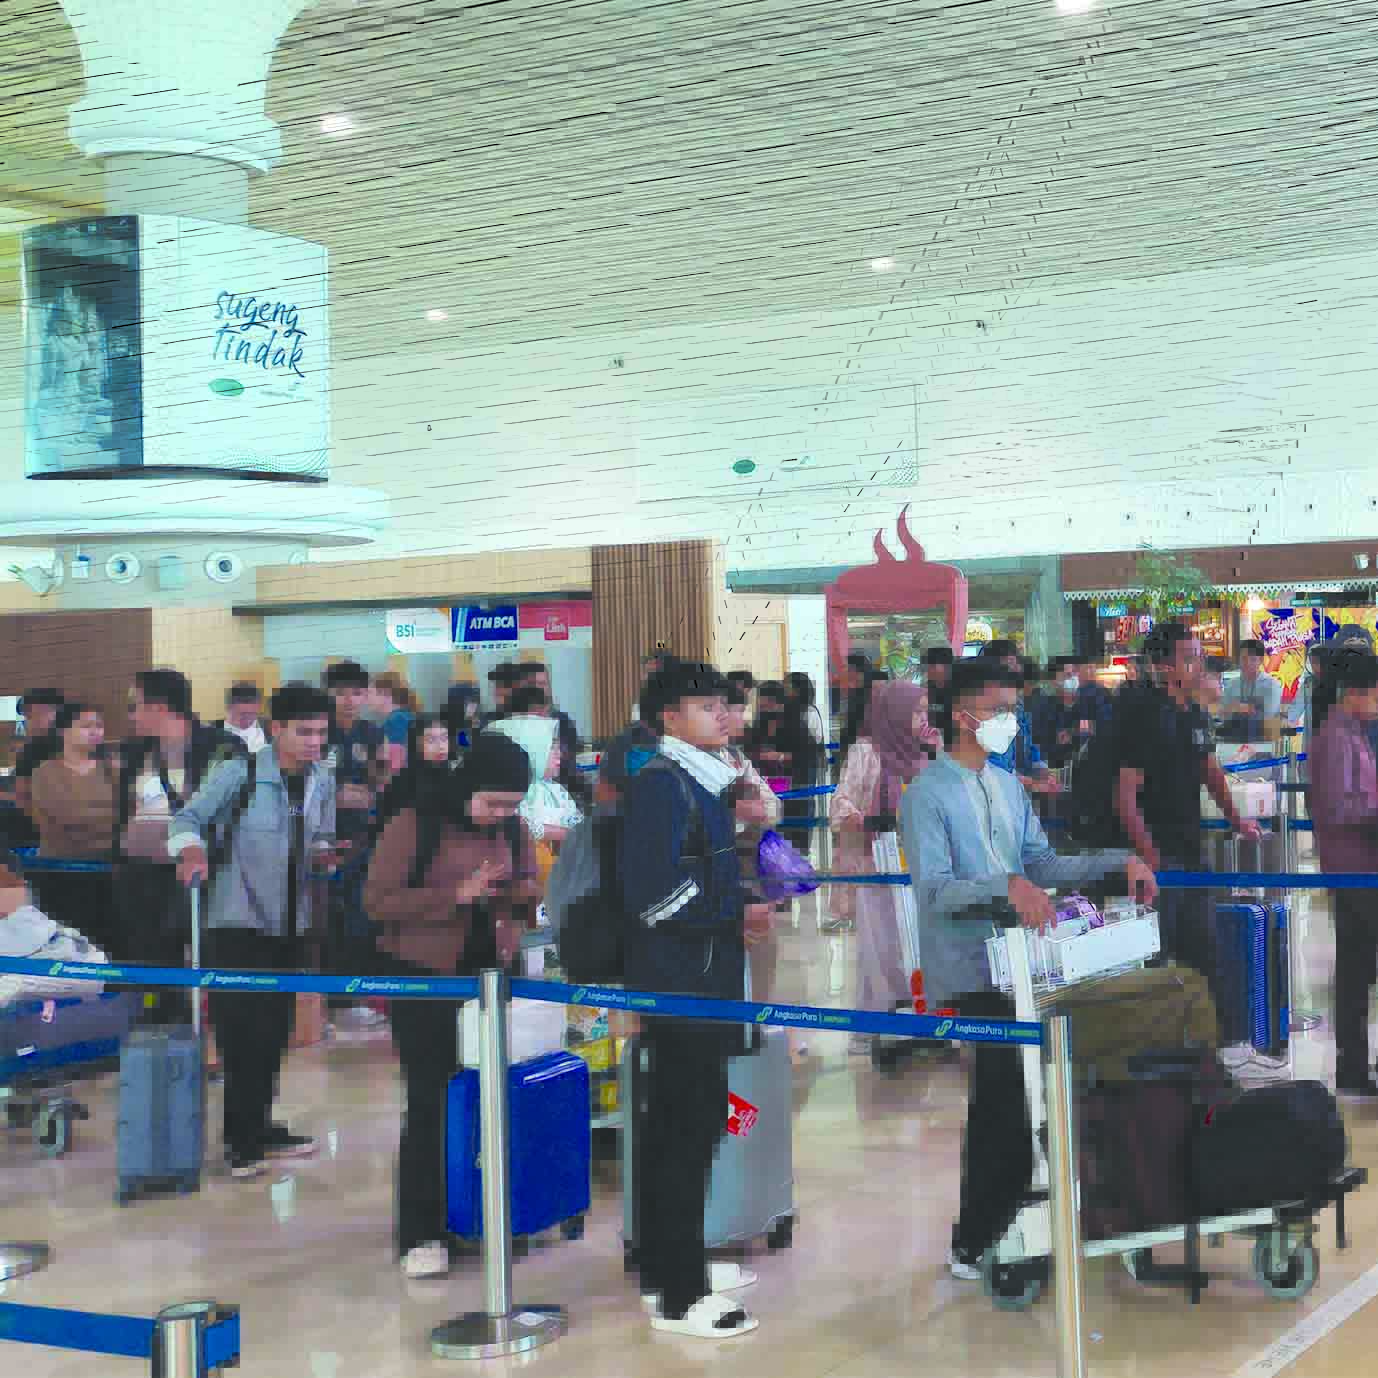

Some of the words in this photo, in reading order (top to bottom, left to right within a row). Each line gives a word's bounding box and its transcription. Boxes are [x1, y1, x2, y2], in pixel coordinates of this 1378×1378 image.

[469, 616, 493, 630] ATM
[494, 615, 515, 629] BCA
[395, 623, 415, 638] BSI
